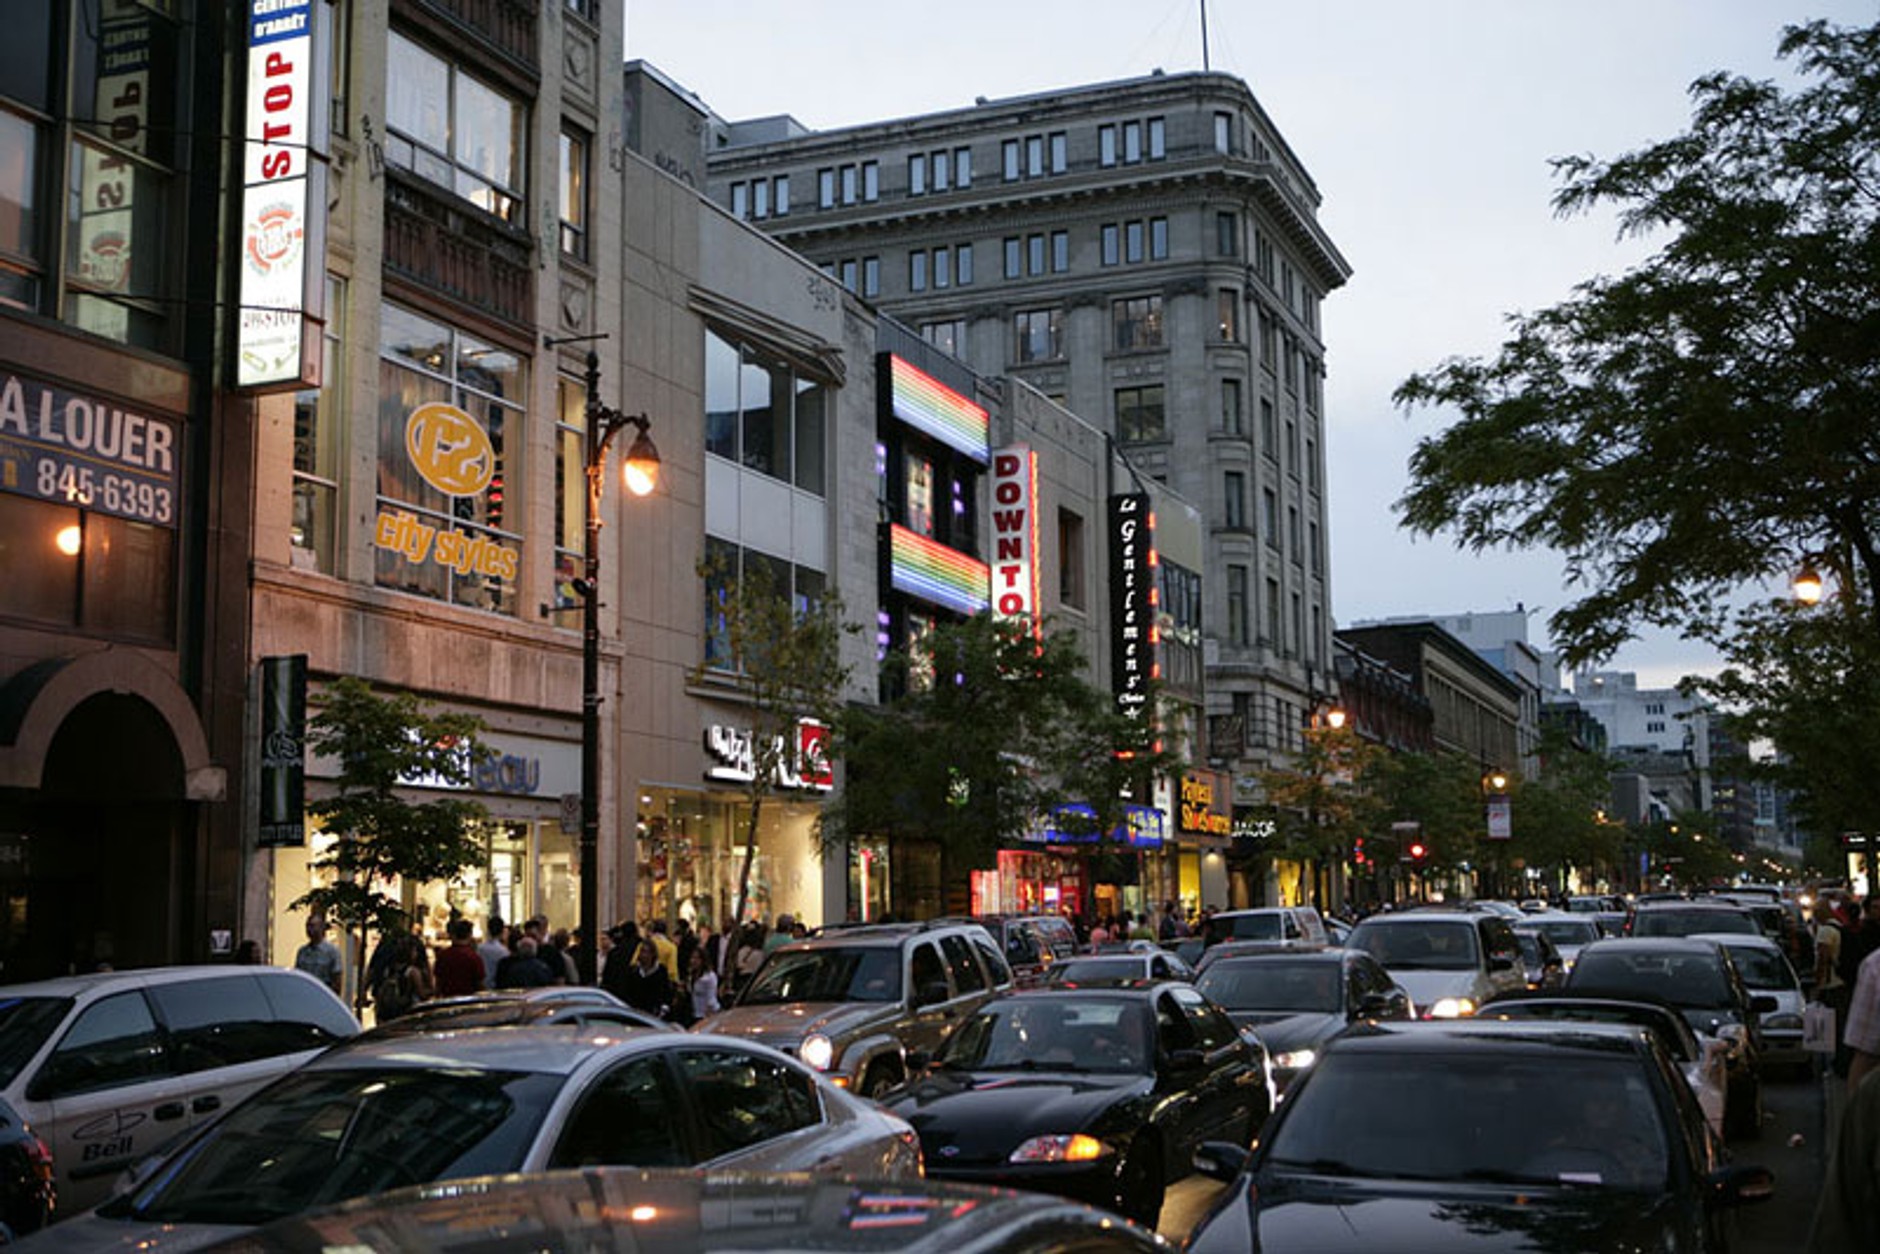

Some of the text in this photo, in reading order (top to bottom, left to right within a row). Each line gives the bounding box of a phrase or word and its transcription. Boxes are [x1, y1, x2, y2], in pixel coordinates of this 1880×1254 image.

[262, 51, 294, 180] STOP
[40, 390, 173, 473] LOUER
[37, 457, 171, 523] 845-6393
[375, 510, 518, 582] city styles
[992, 455, 1027, 642] DOWNTO
[82, 1135, 133, 1163] Bell
